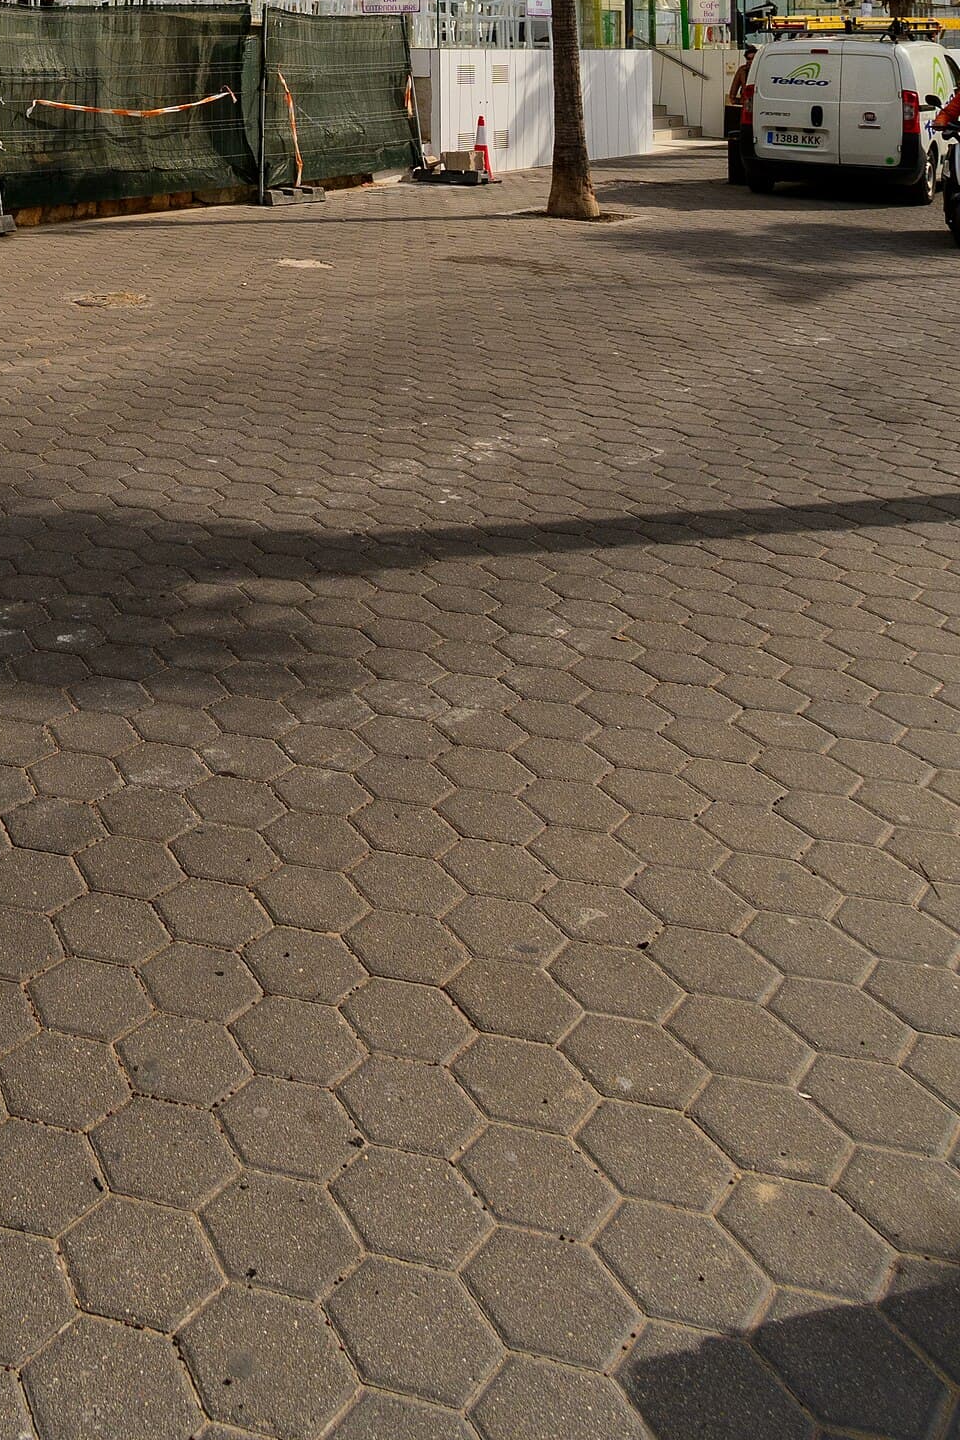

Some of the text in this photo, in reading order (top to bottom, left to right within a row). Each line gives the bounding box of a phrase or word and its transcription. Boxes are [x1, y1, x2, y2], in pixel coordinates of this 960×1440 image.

[771, 77, 829, 86] Teleco
[775, 134, 821, 144] 1388 KKK
